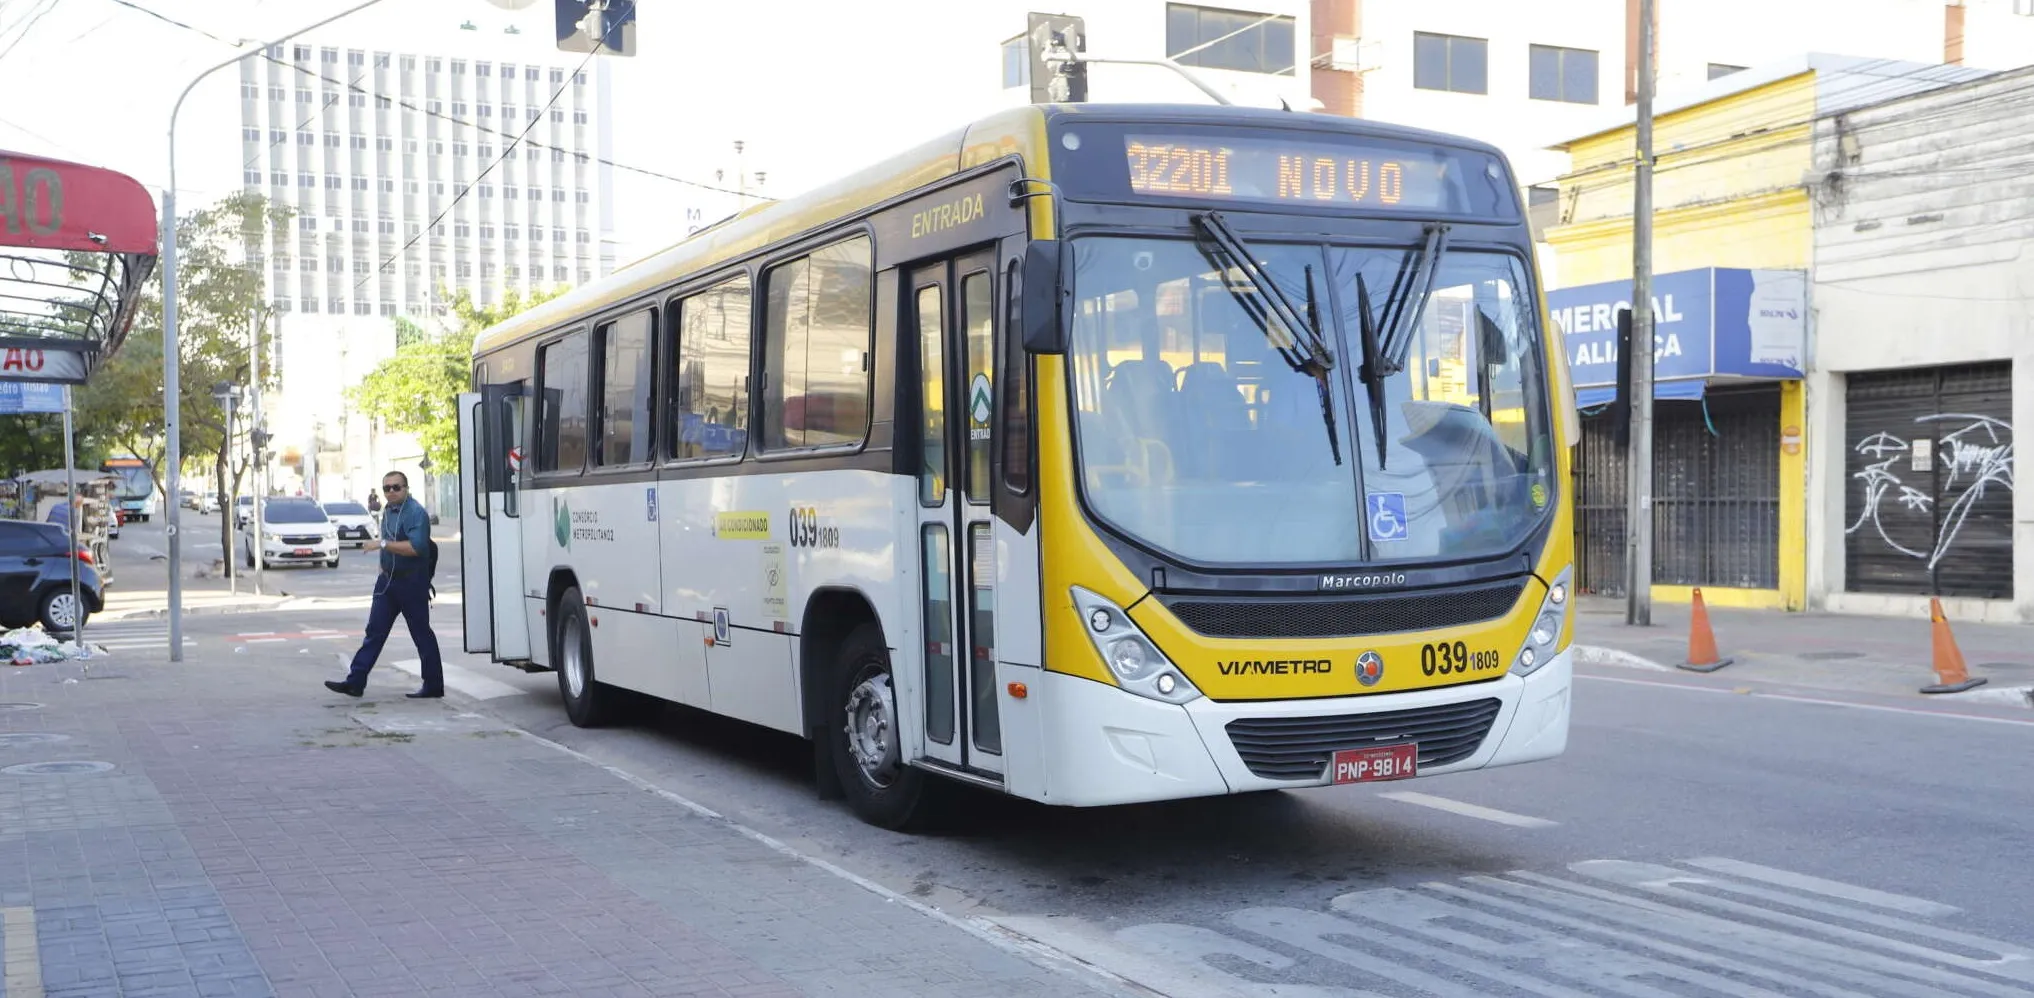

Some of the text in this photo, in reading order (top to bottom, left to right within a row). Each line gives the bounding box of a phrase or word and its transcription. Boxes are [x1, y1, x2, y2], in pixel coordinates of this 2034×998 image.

[1279, 155, 1401, 203] NOVO
[911, 192, 984, 238] ENTRADA
[728, 518, 768, 532] CONDICIONADO
[789, 507, 840, 548] 039 1809
[1322, 572, 1405, 588] Marcopolo
[1217, 659, 1332, 675] VIAMETRO
[1421, 641, 1499, 677] 039 1809
